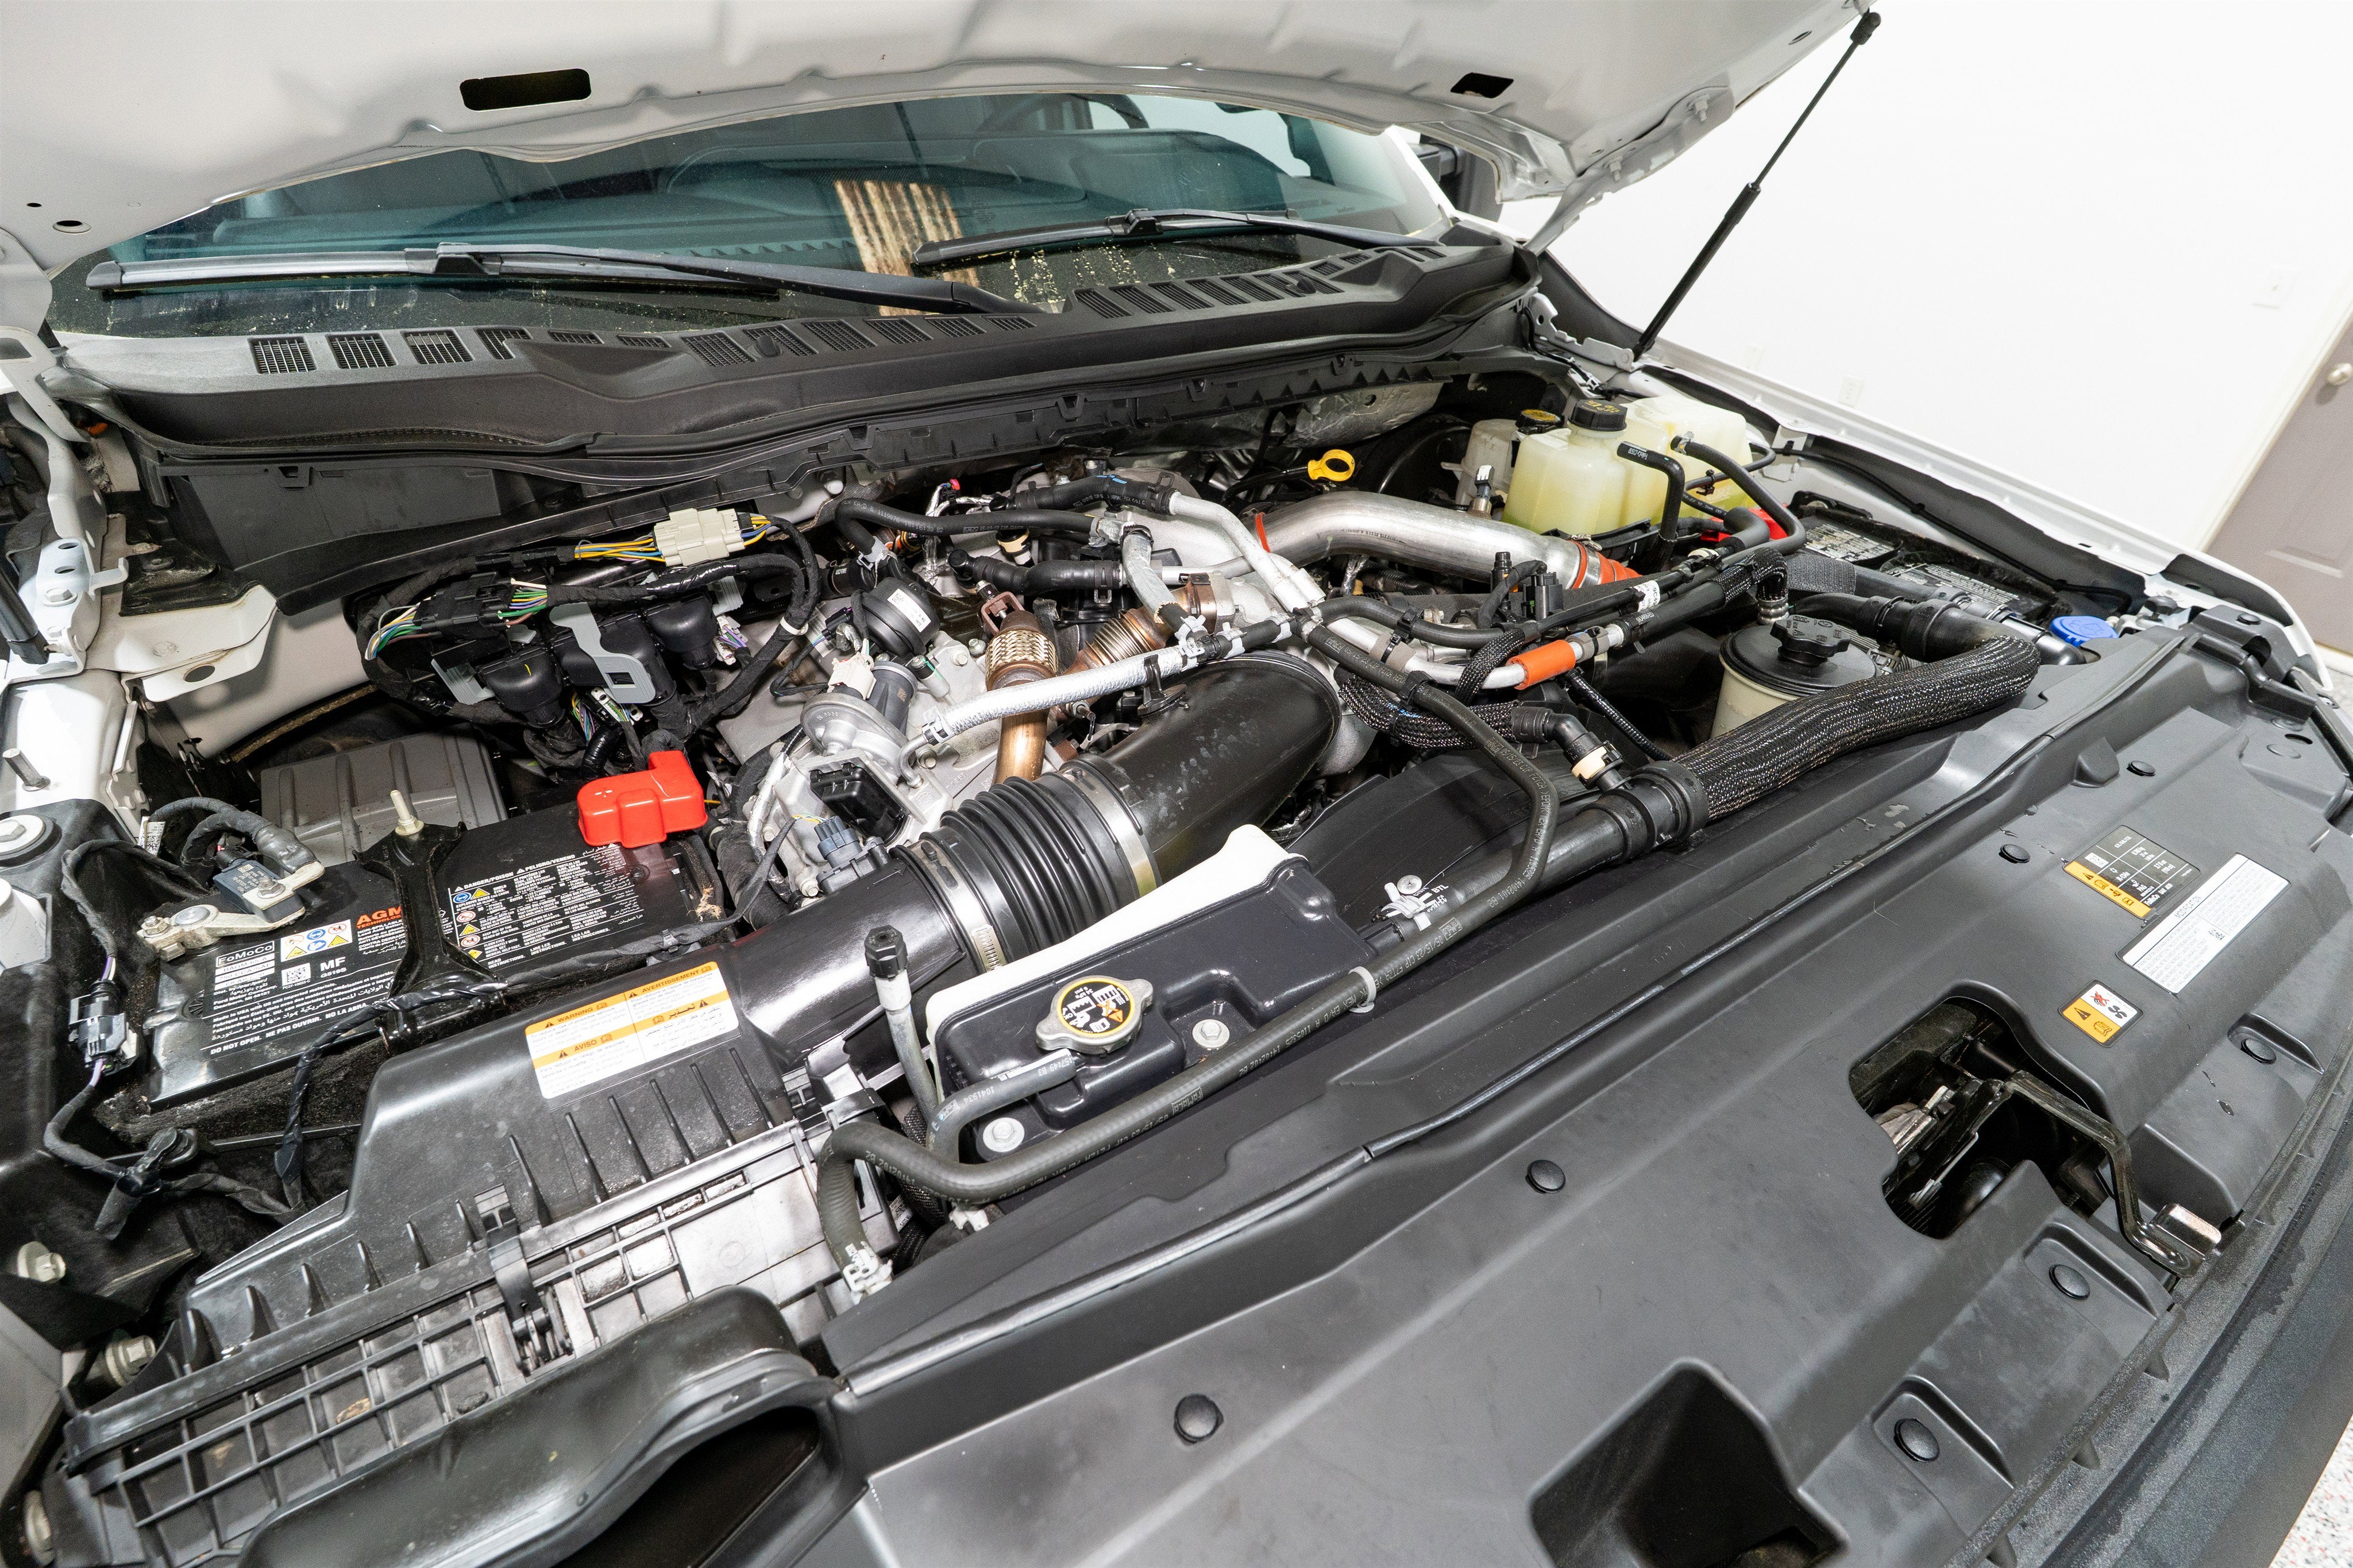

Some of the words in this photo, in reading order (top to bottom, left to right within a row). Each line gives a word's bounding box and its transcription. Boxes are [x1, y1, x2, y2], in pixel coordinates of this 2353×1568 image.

[1344, 646, 1368, 665] 05/15/23
[1500, 748, 1523, 766] 05/15/23
[1519, 763, 1533, 773] CIP
[463, 871, 514, 889] DANGER/POISON
[525, 853, 575, 871] PELIGRO/VENENO
[2115, 871, 2131, 882] R-134a
[1431, 885, 1449, 894] BTL
[2136, 884, 2147, 892] PAG
[2143, 893, 2161, 906] FoMoCo
[2174, 895, 2202, 918] MODIFICATION
[357, 914, 401, 929] TECHNOLOG
[572, 927, 610, 942] INSTRUCCIONES.
[358, 940, 380, 948] CONTRA
[530, 941, 566, 955] INSTRUCTIONS.
[1417, 936, 1443, 961] 05/15/23
[218, 944, 272, 964] FoMoCo
[488, 954, 526, 968] INSTRUCTIONS.
[319, 956, 346, 972] MF
[1405, 956, 1415, 968] CIP
[642, 969, 699, 993] AVERTISSEMENT
[229, 992, 247, 1001] Motor
[213, 1014, 229, 1022] Made
[557, 1007, 593, 1022] WARNING
[210, 1046, 222, 1055] DO
[222, 1041, 238, 1051] NOT
[239, 1034, 263, 1046] OPEN.
[265, 1030, 276, 1038] NE
[276, 1025, 291, 1034] PAS
[292, 1015, 322, 1029] OUVRIR.
[325, 1011, 335, 1019] NO
[348, 1001, 369, 1012] ABRA.
[574, 1039, 597, 1051] AVISO
[963, 1086, 994, 1104] 1041934
